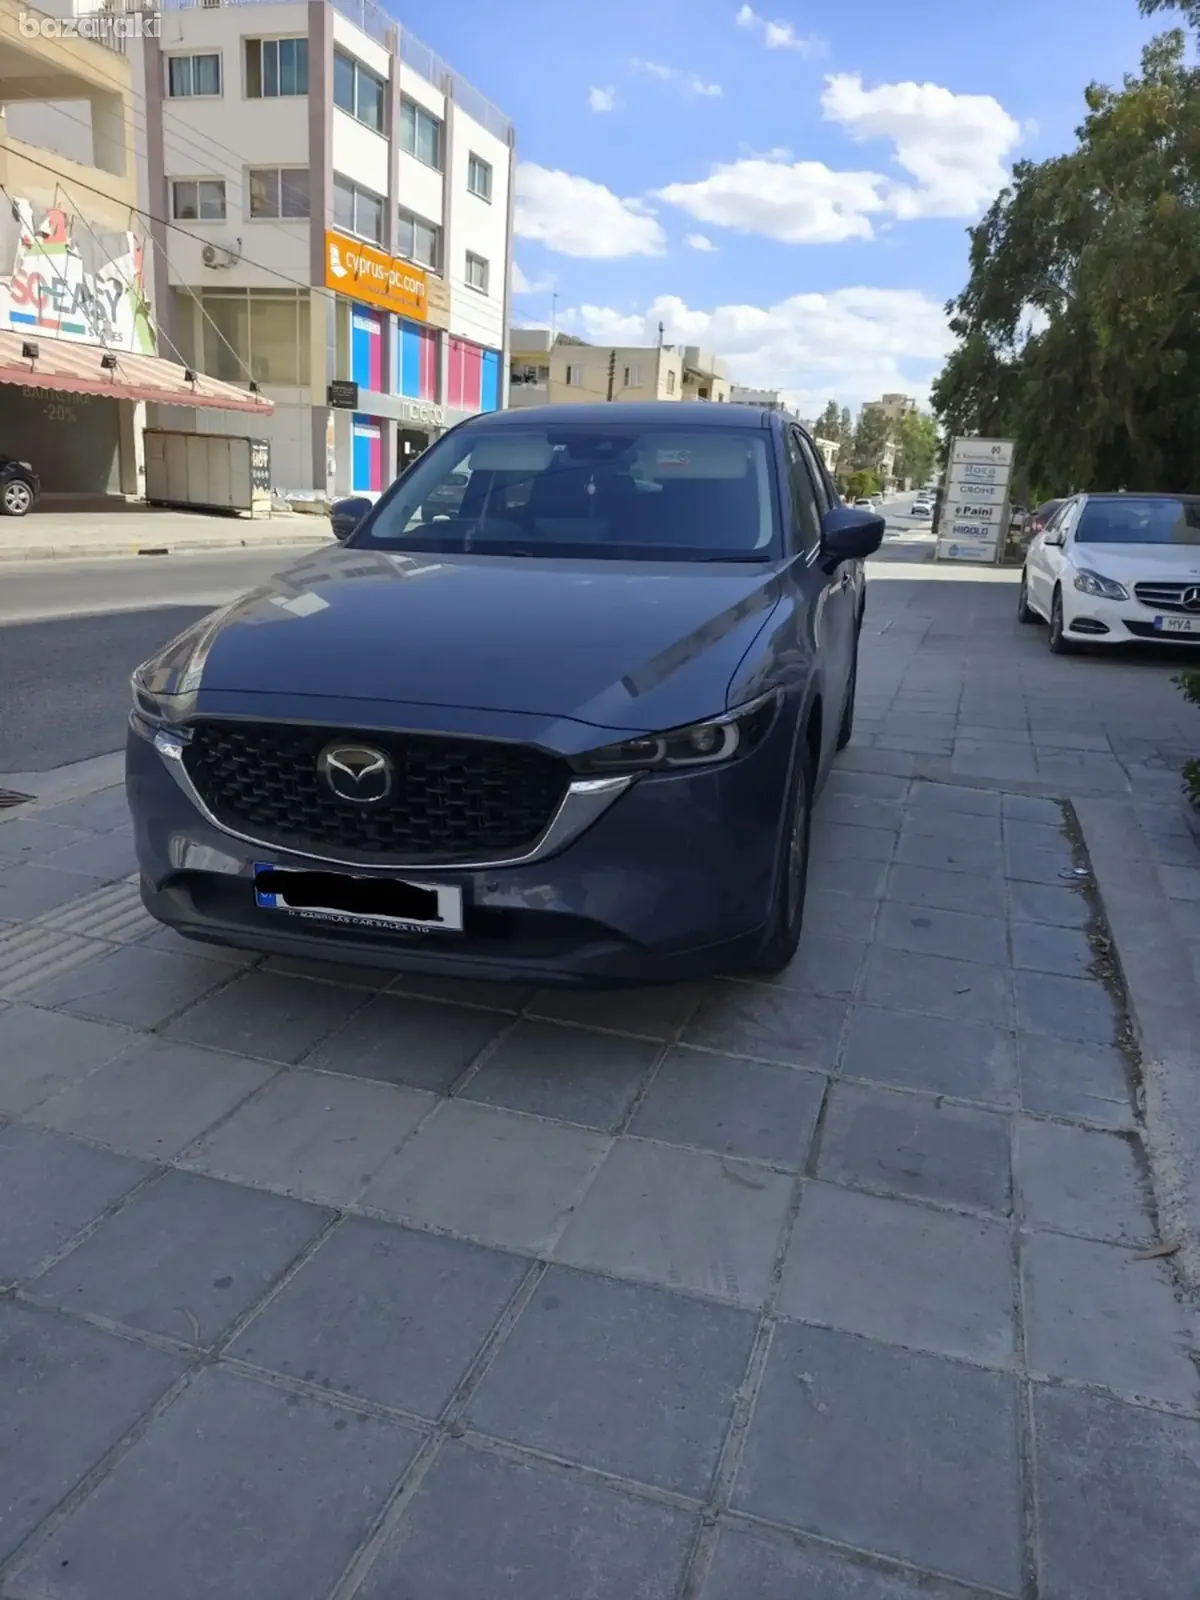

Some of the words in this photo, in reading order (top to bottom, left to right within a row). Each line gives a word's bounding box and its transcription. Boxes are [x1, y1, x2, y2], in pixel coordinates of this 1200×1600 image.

[345, 251, 425, 297] cyprus-pc.com
[959, 486, 996, 495] GROHE
[352, 918, 375, 926] CAR
